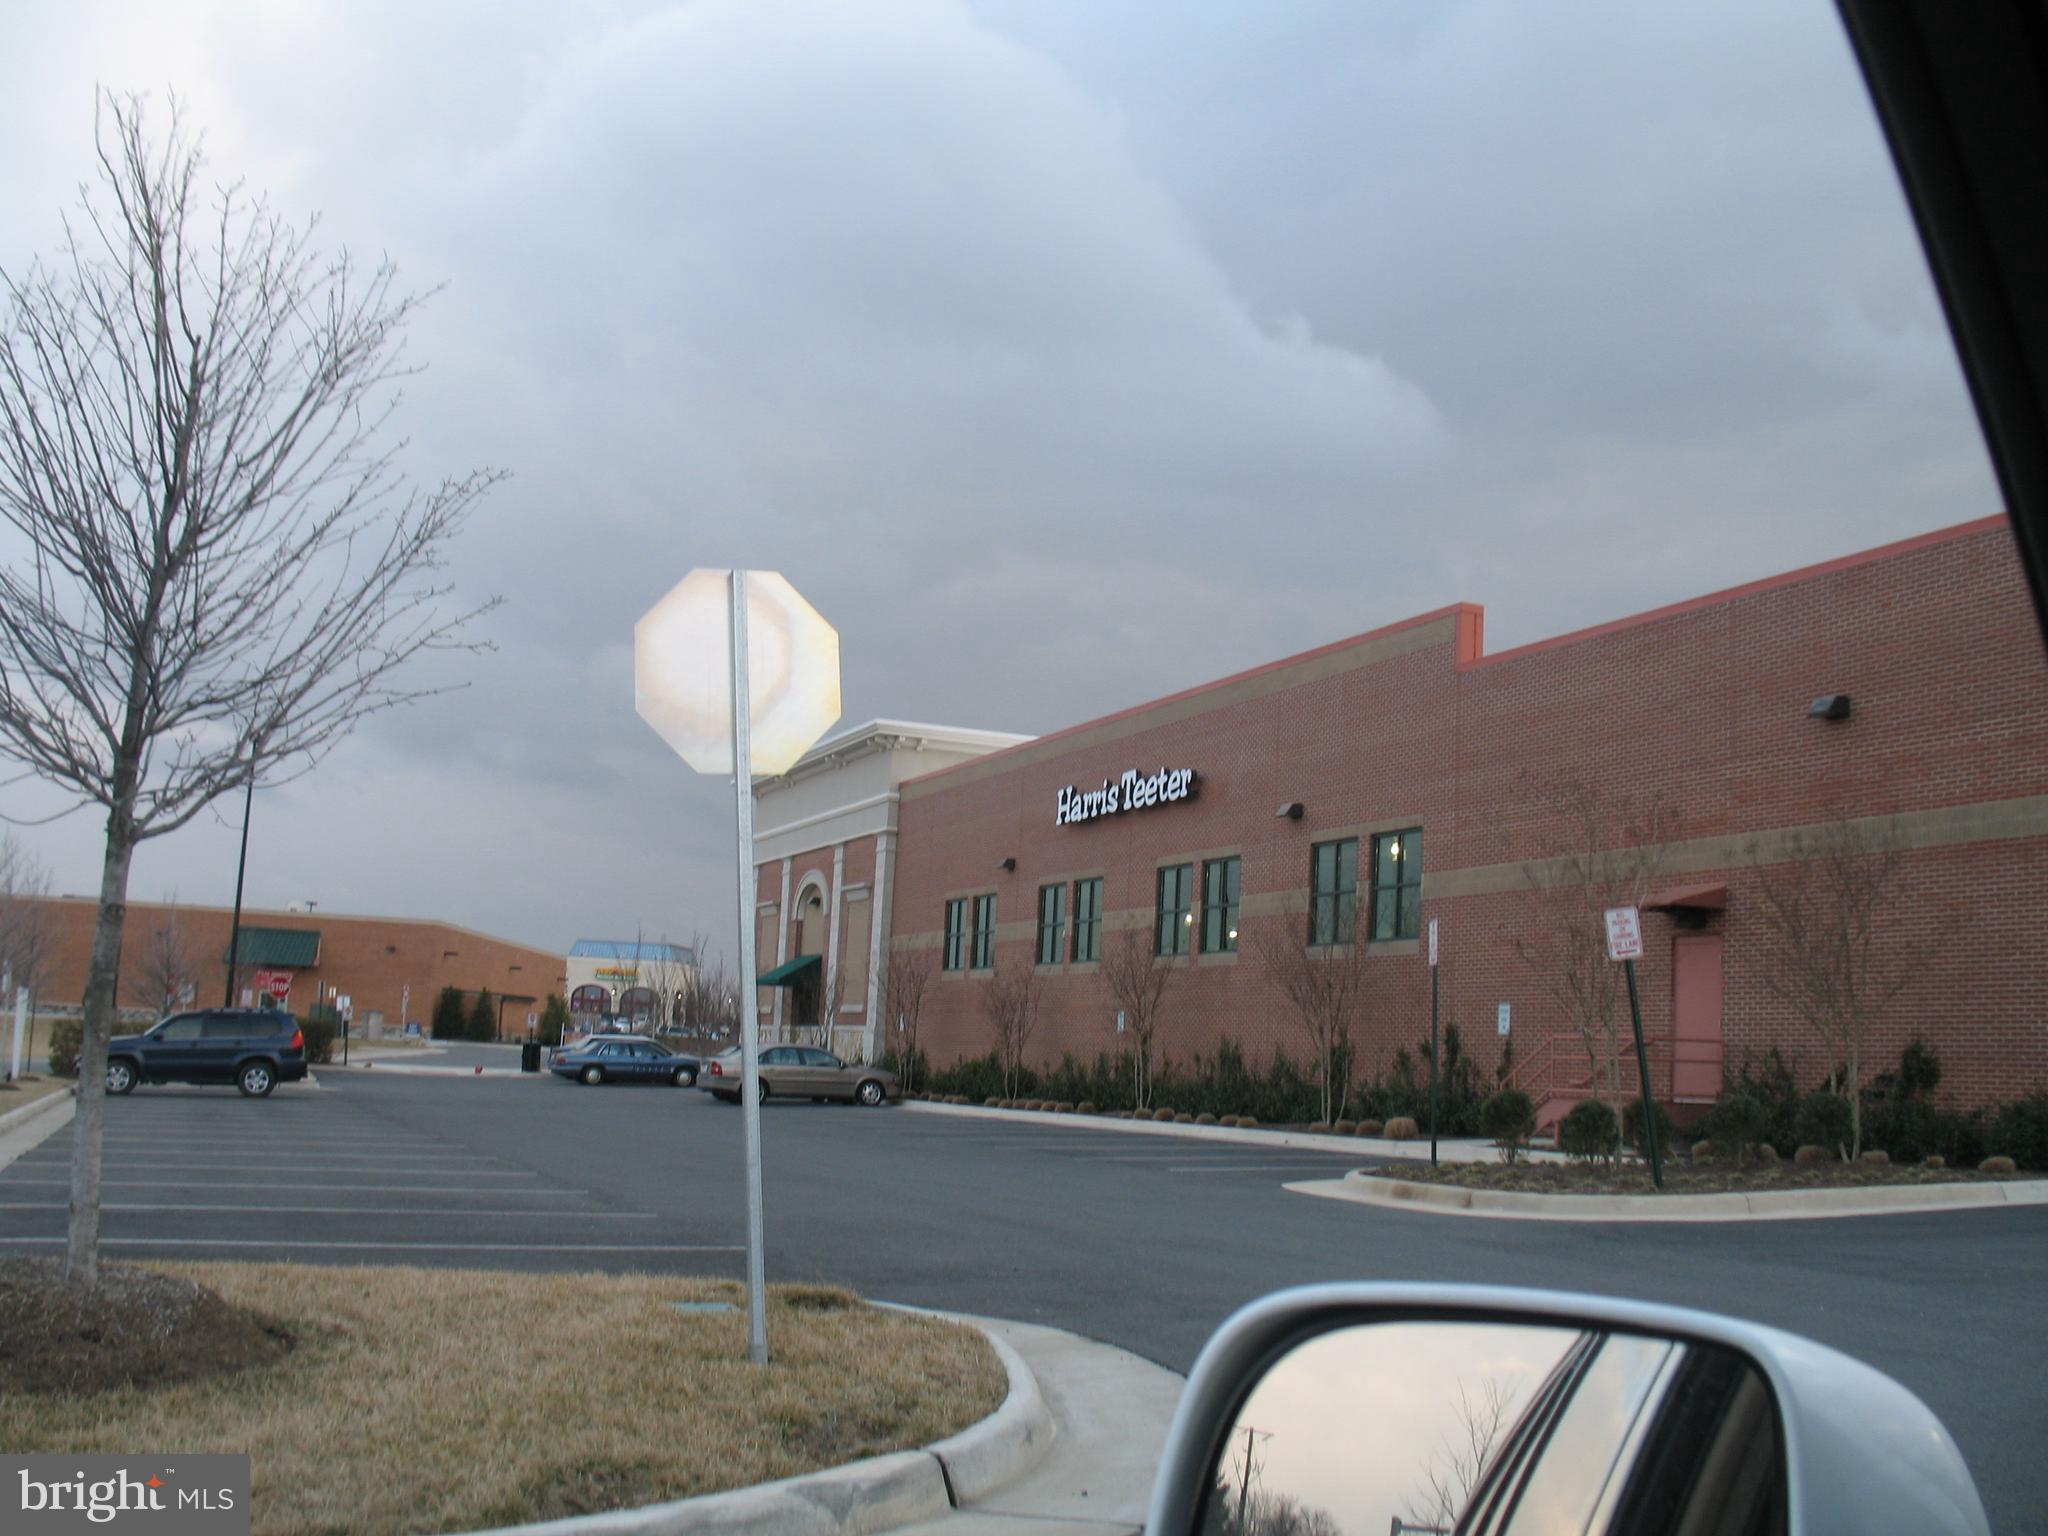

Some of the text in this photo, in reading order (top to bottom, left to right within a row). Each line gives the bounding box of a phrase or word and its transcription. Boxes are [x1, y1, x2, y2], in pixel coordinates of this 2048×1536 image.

[1056, 766, 1192, 826] Harris Teeter
[271, 982, 290, 992] STOP
